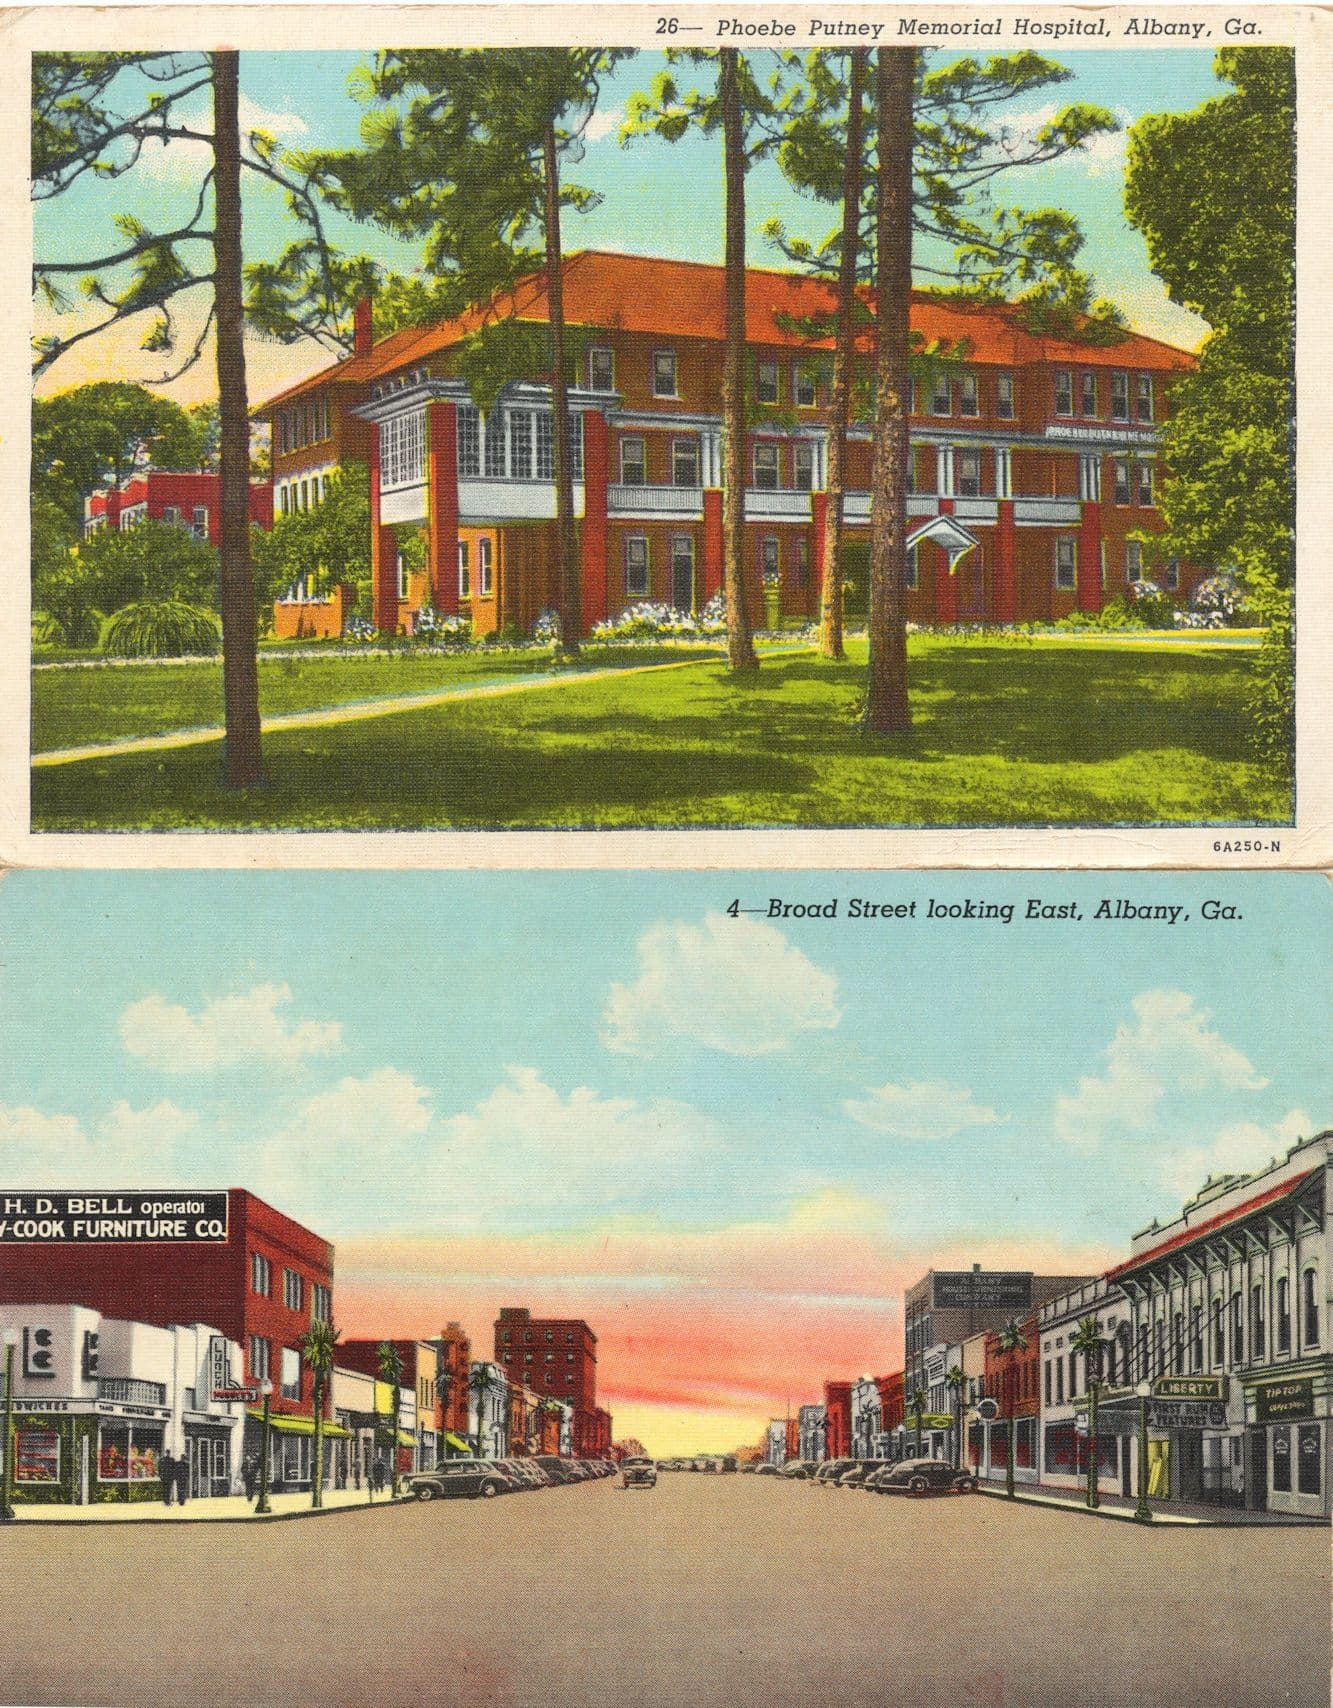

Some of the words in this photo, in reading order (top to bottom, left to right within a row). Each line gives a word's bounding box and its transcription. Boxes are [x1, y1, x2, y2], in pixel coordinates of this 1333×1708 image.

[4, 1198, 27, 1215] H.
[35, 1198, 59, 1215] D.
[67, 1198, 132, 1215] BELL
[73, 1219, 188, 1238] FURNITURE
[1161, 1383, 1213, 1395] LIBERTY
[1265, 1387, 1282, 1399] TIP
[1283, 1384, 1302, 1396] TOP
